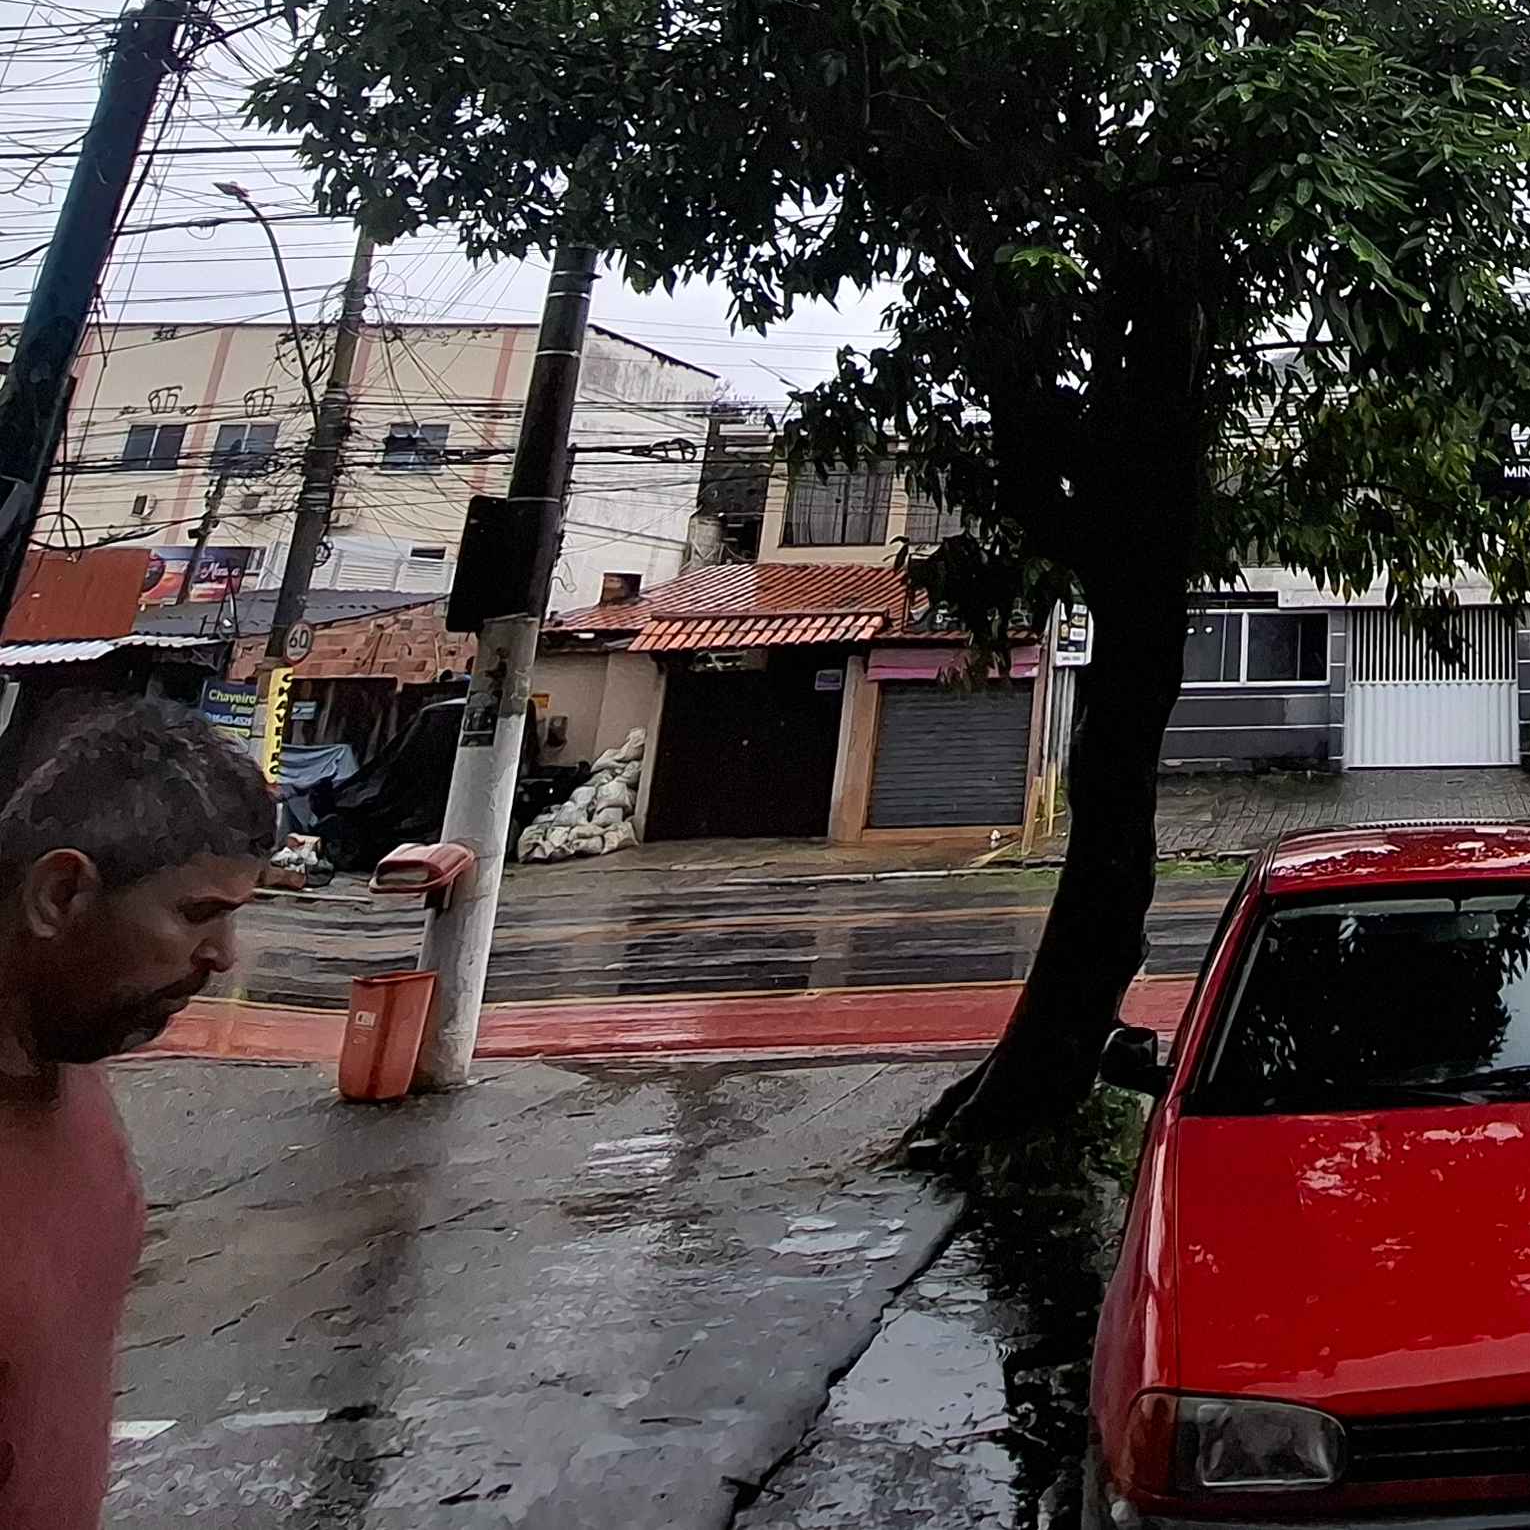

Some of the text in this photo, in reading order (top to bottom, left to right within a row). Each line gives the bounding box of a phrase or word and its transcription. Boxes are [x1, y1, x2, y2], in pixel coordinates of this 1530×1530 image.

[288, 629, 309, 649] 60
[208, 689, 257, 705] Chaveiro
[269, 673, 292, 774] CHAVEIRO
